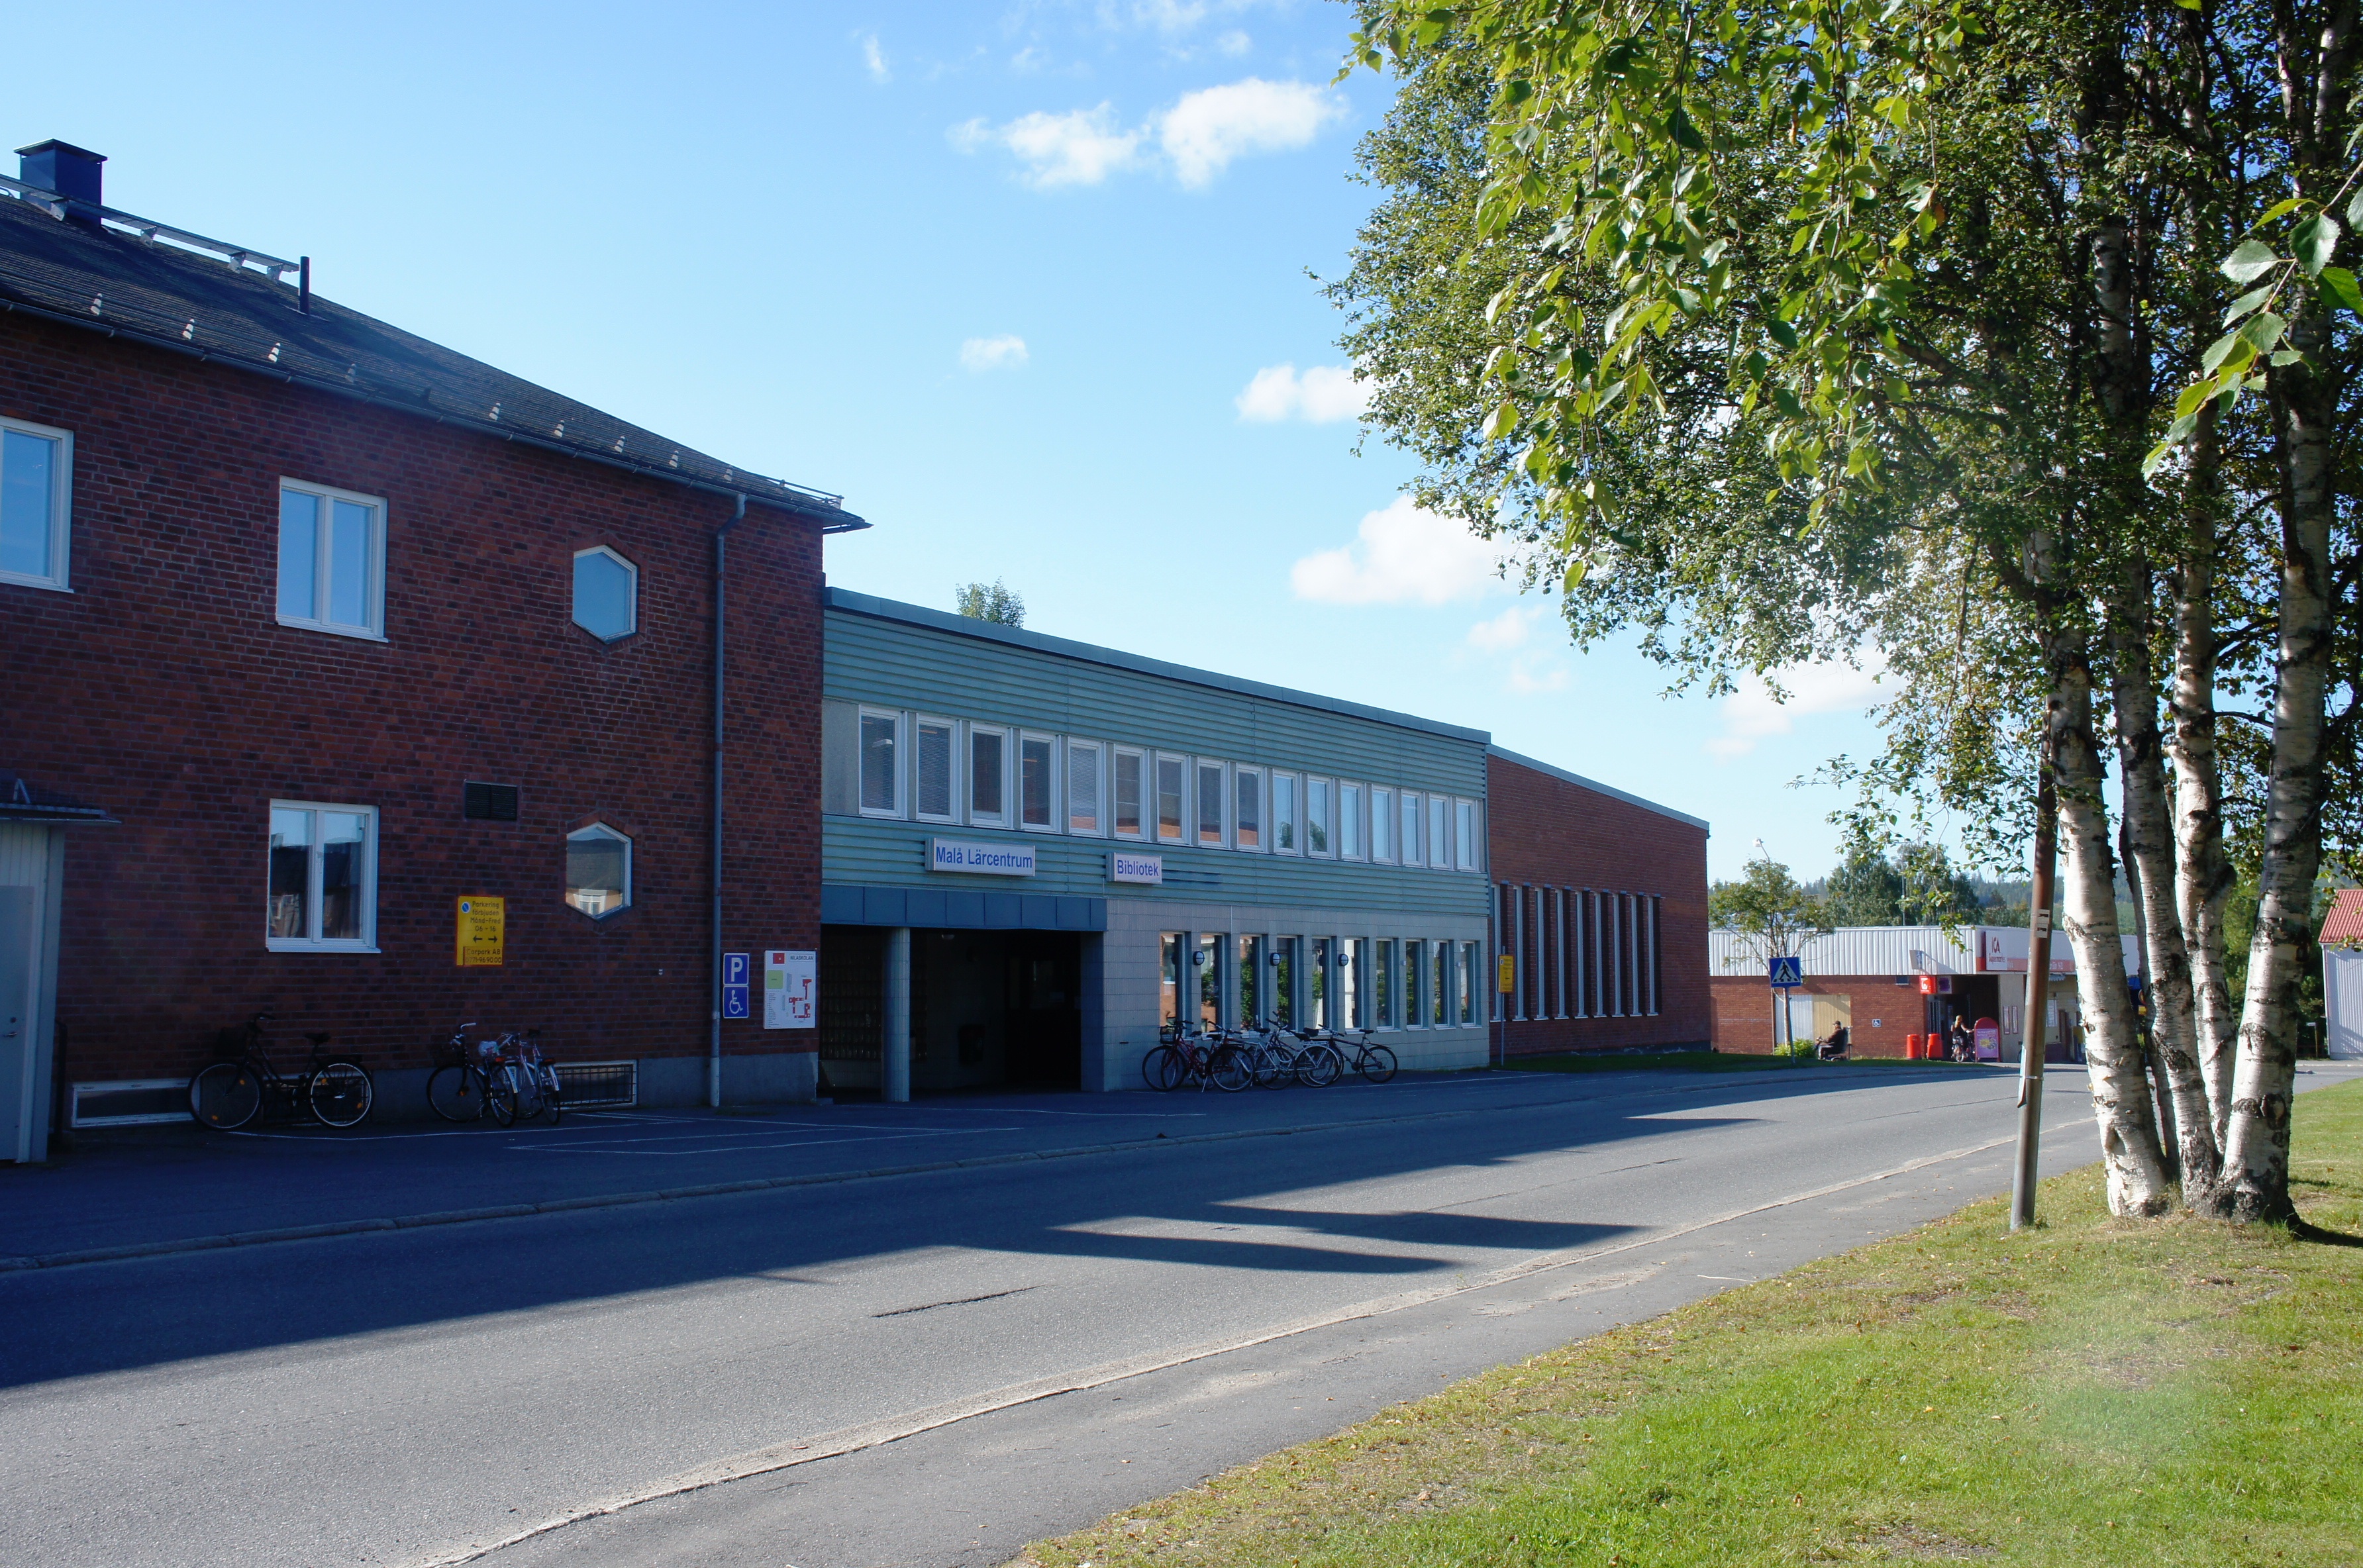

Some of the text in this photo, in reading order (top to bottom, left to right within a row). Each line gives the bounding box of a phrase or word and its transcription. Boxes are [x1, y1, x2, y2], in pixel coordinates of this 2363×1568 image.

[936, 846, 1032, 869] Malå Lärcentrum
[1117, 859, 1159, 877] Bibliotek
[1992, 936, 2001, 953] ICA
[730, 957, 743, 982] P
